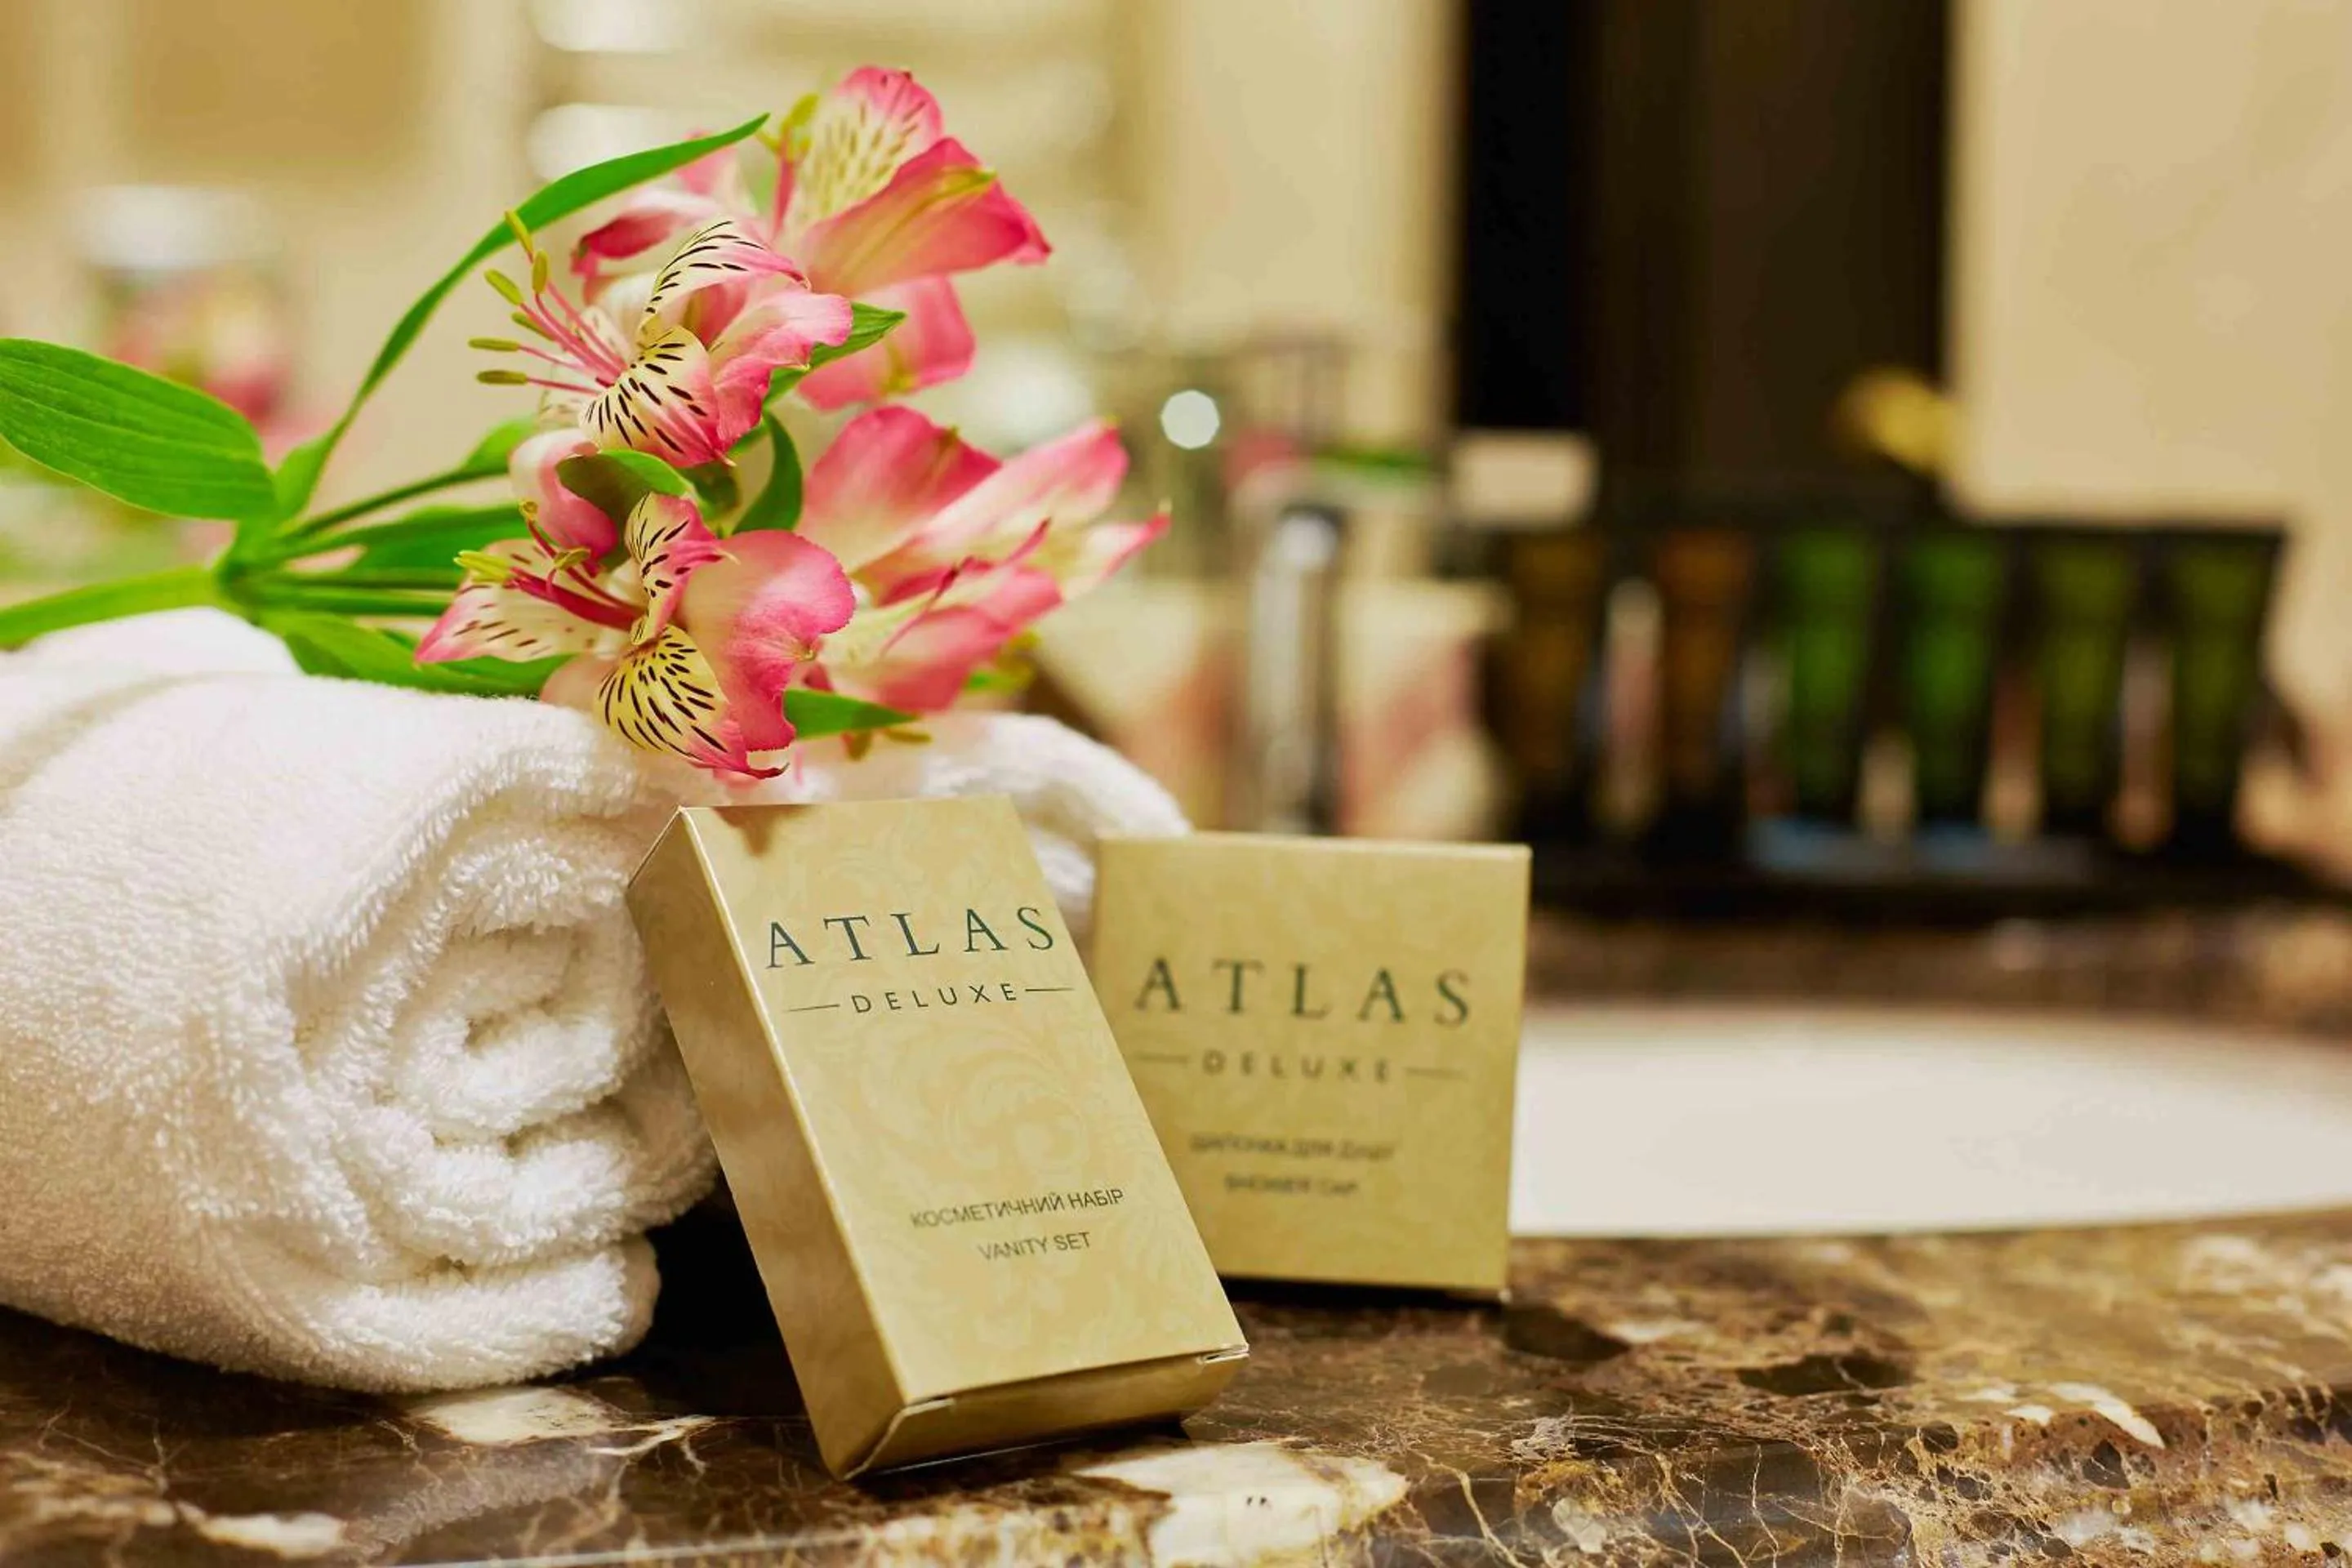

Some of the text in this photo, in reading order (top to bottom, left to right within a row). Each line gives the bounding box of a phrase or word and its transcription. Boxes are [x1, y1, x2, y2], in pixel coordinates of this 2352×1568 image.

[766, 906, 1055, 969] ATLAS
[852, 983, 1018, 1013] DELUXE
[1134, 956, 1471, 1027] ATLAS
[1202, 1049, 1390, 1082] DELUXE
[911, 1192, 1065, 1228] КОСМЕТИЧНИЙ
[1067, 1188, 1125, 1209] НАБІР
[978, 1236, 1048, 1260] VANITY
[1054, 1232, 1091, 1252] SET
